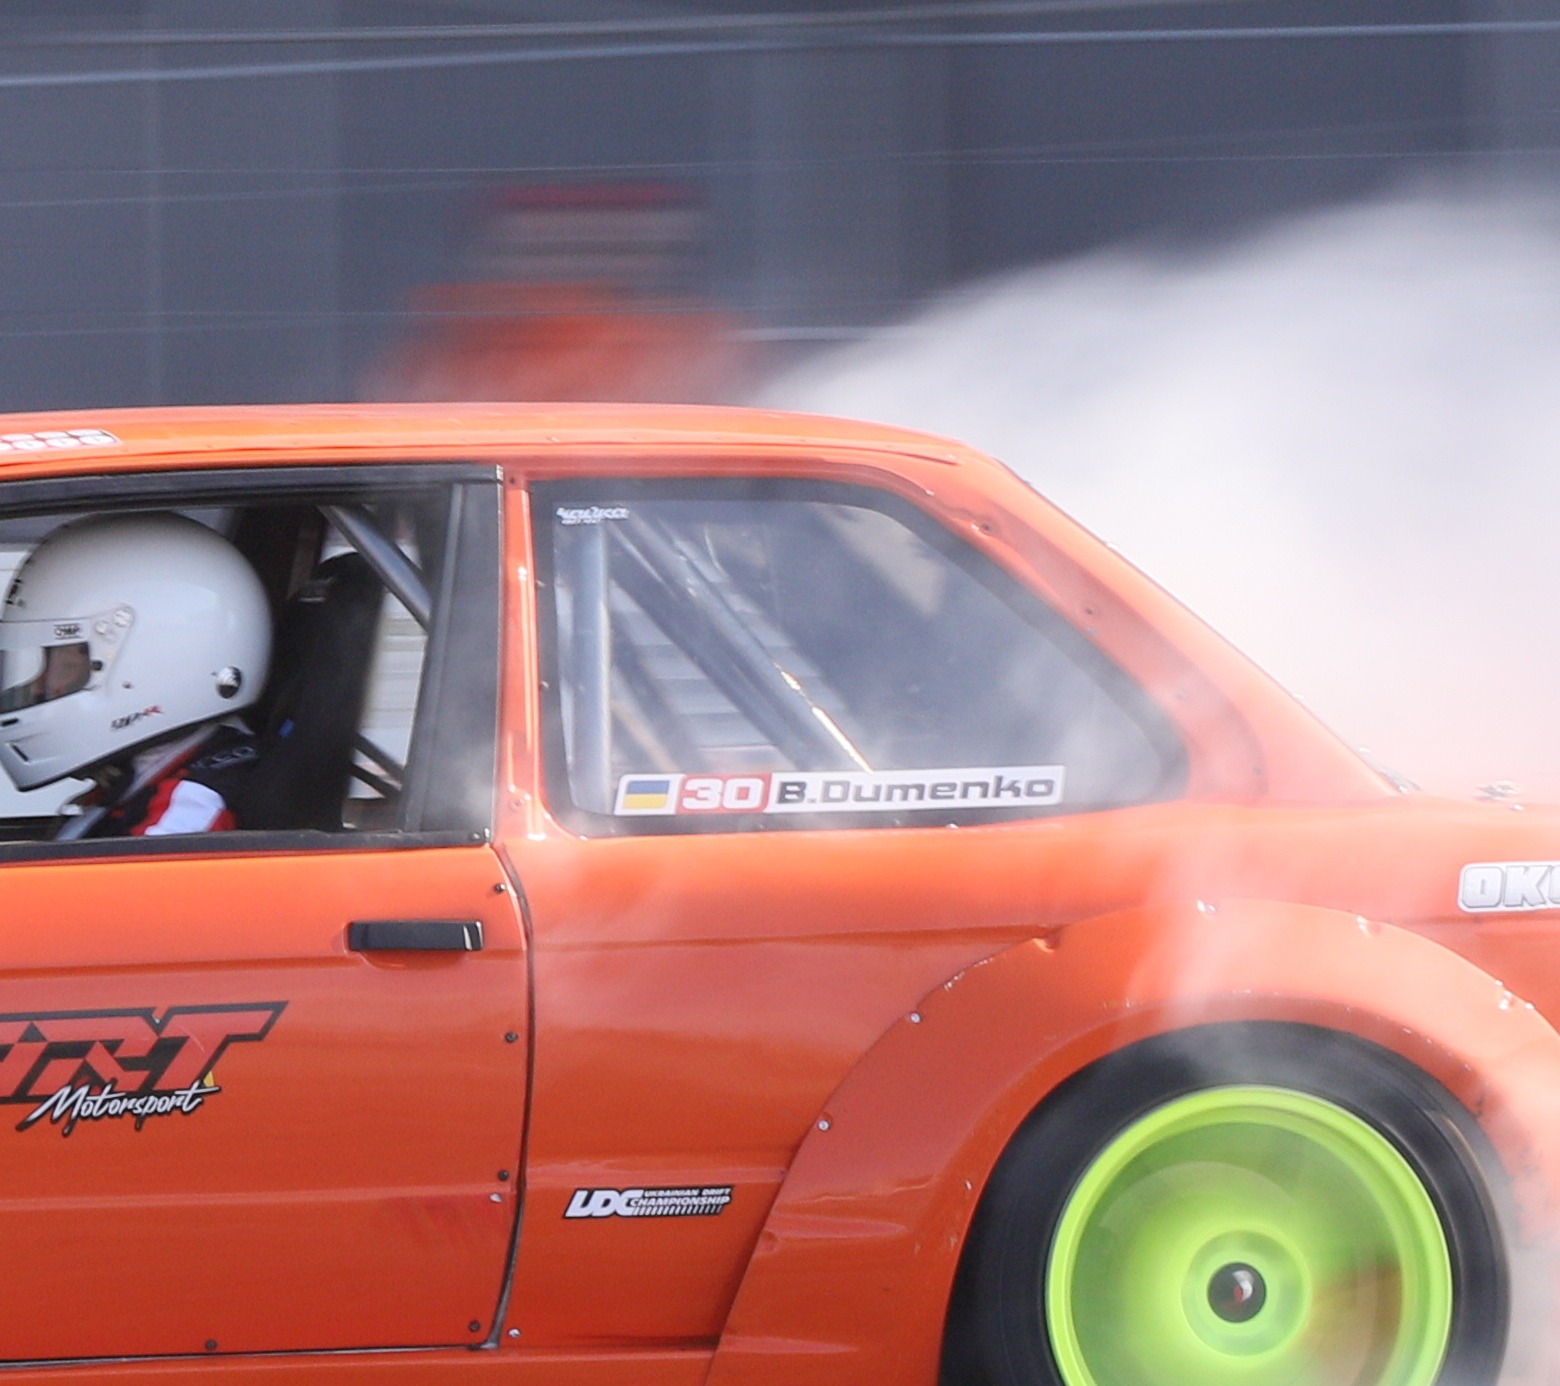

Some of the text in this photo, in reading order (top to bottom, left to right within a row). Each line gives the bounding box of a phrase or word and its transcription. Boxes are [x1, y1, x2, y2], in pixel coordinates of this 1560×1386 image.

[681, 775, 1055, 811] 30 B.Dumenko
[20, 1082, 221, 1129] Motorsport
[564, 1189, 644, 1218] UDC
[630, 1195, 731, 1207] CHAMPIONSHIP
[644, 1187, 731, 1198] UKRAINIAN DRIFT
